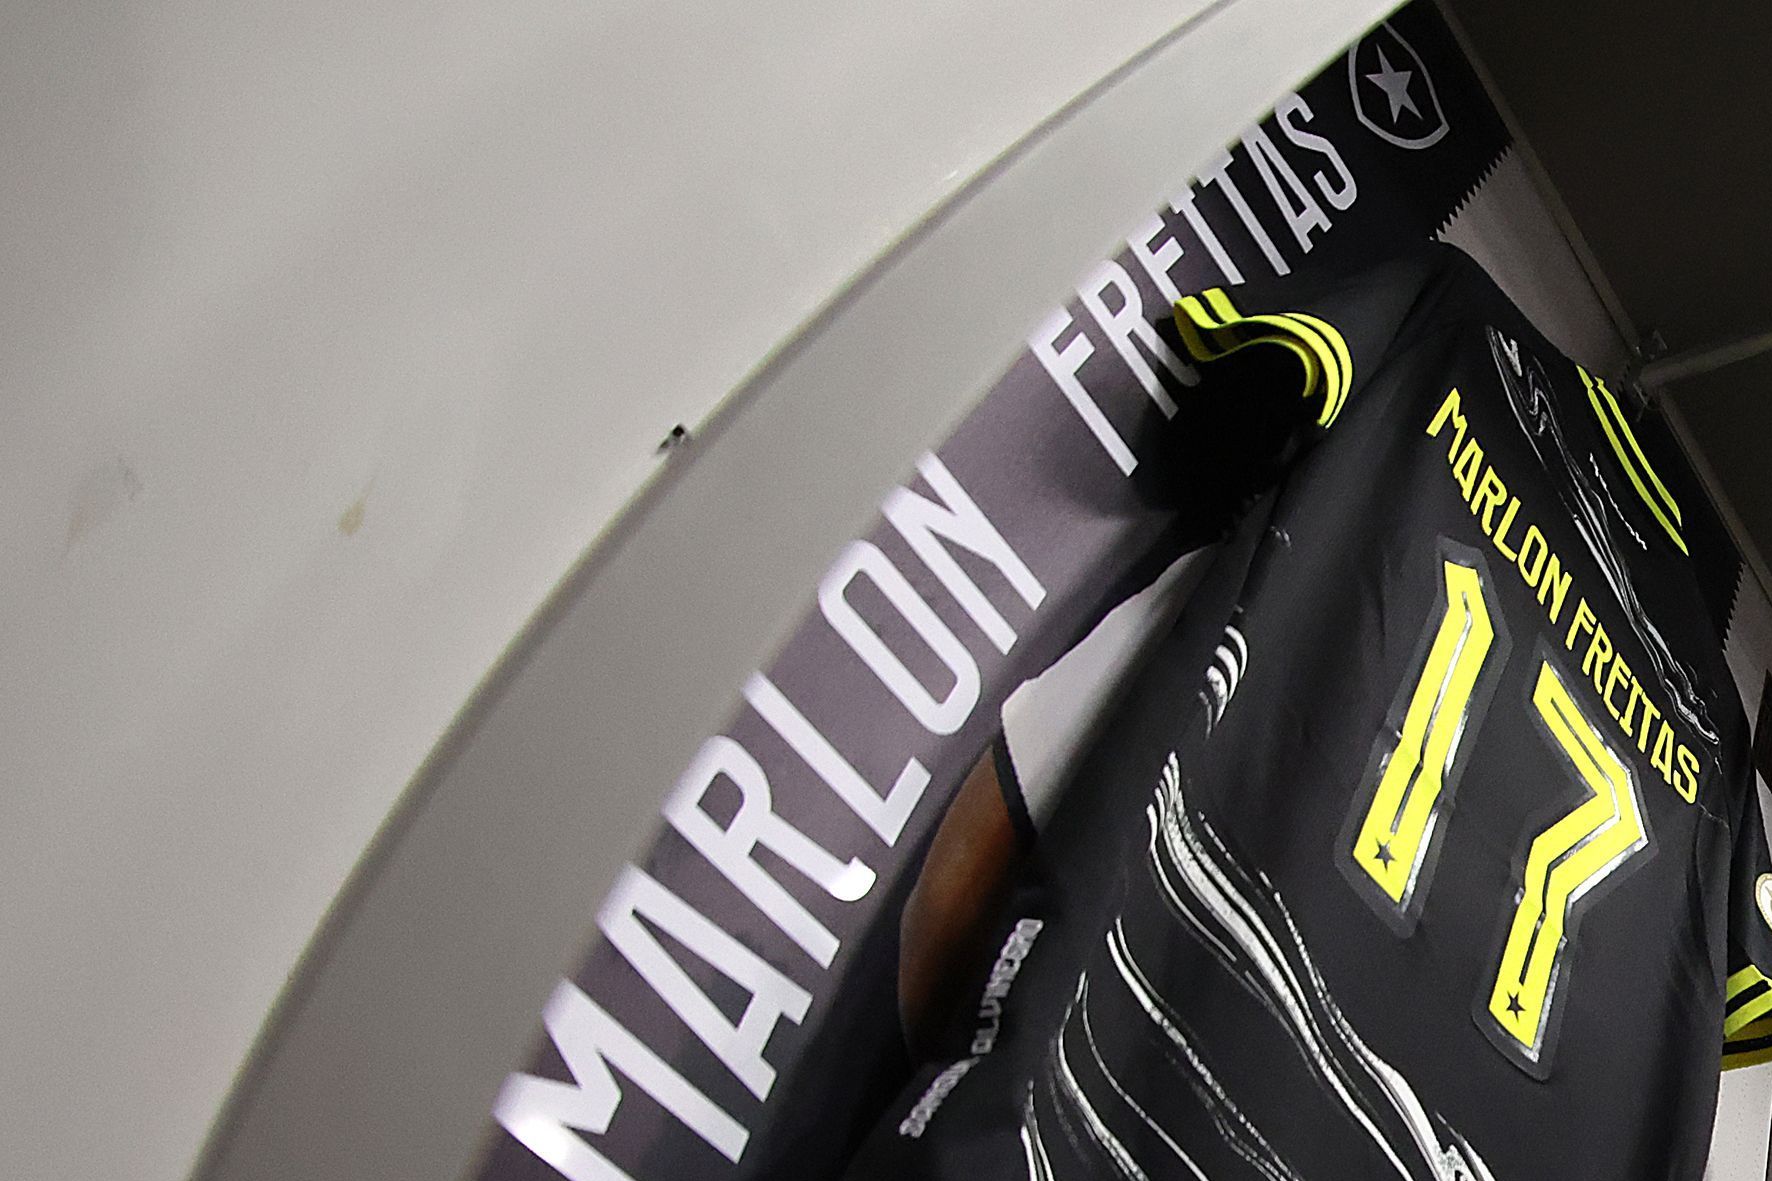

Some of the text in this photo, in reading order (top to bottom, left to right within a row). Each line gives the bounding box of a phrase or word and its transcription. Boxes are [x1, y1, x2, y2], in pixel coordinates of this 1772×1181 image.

[1028, 90, 1357, 478] FREITAS
[1352, 560, 1648, 1048] 17
[1426, 388, 1573, 622] MARLON
[1566, 601, 1699, 805] FREITAS
